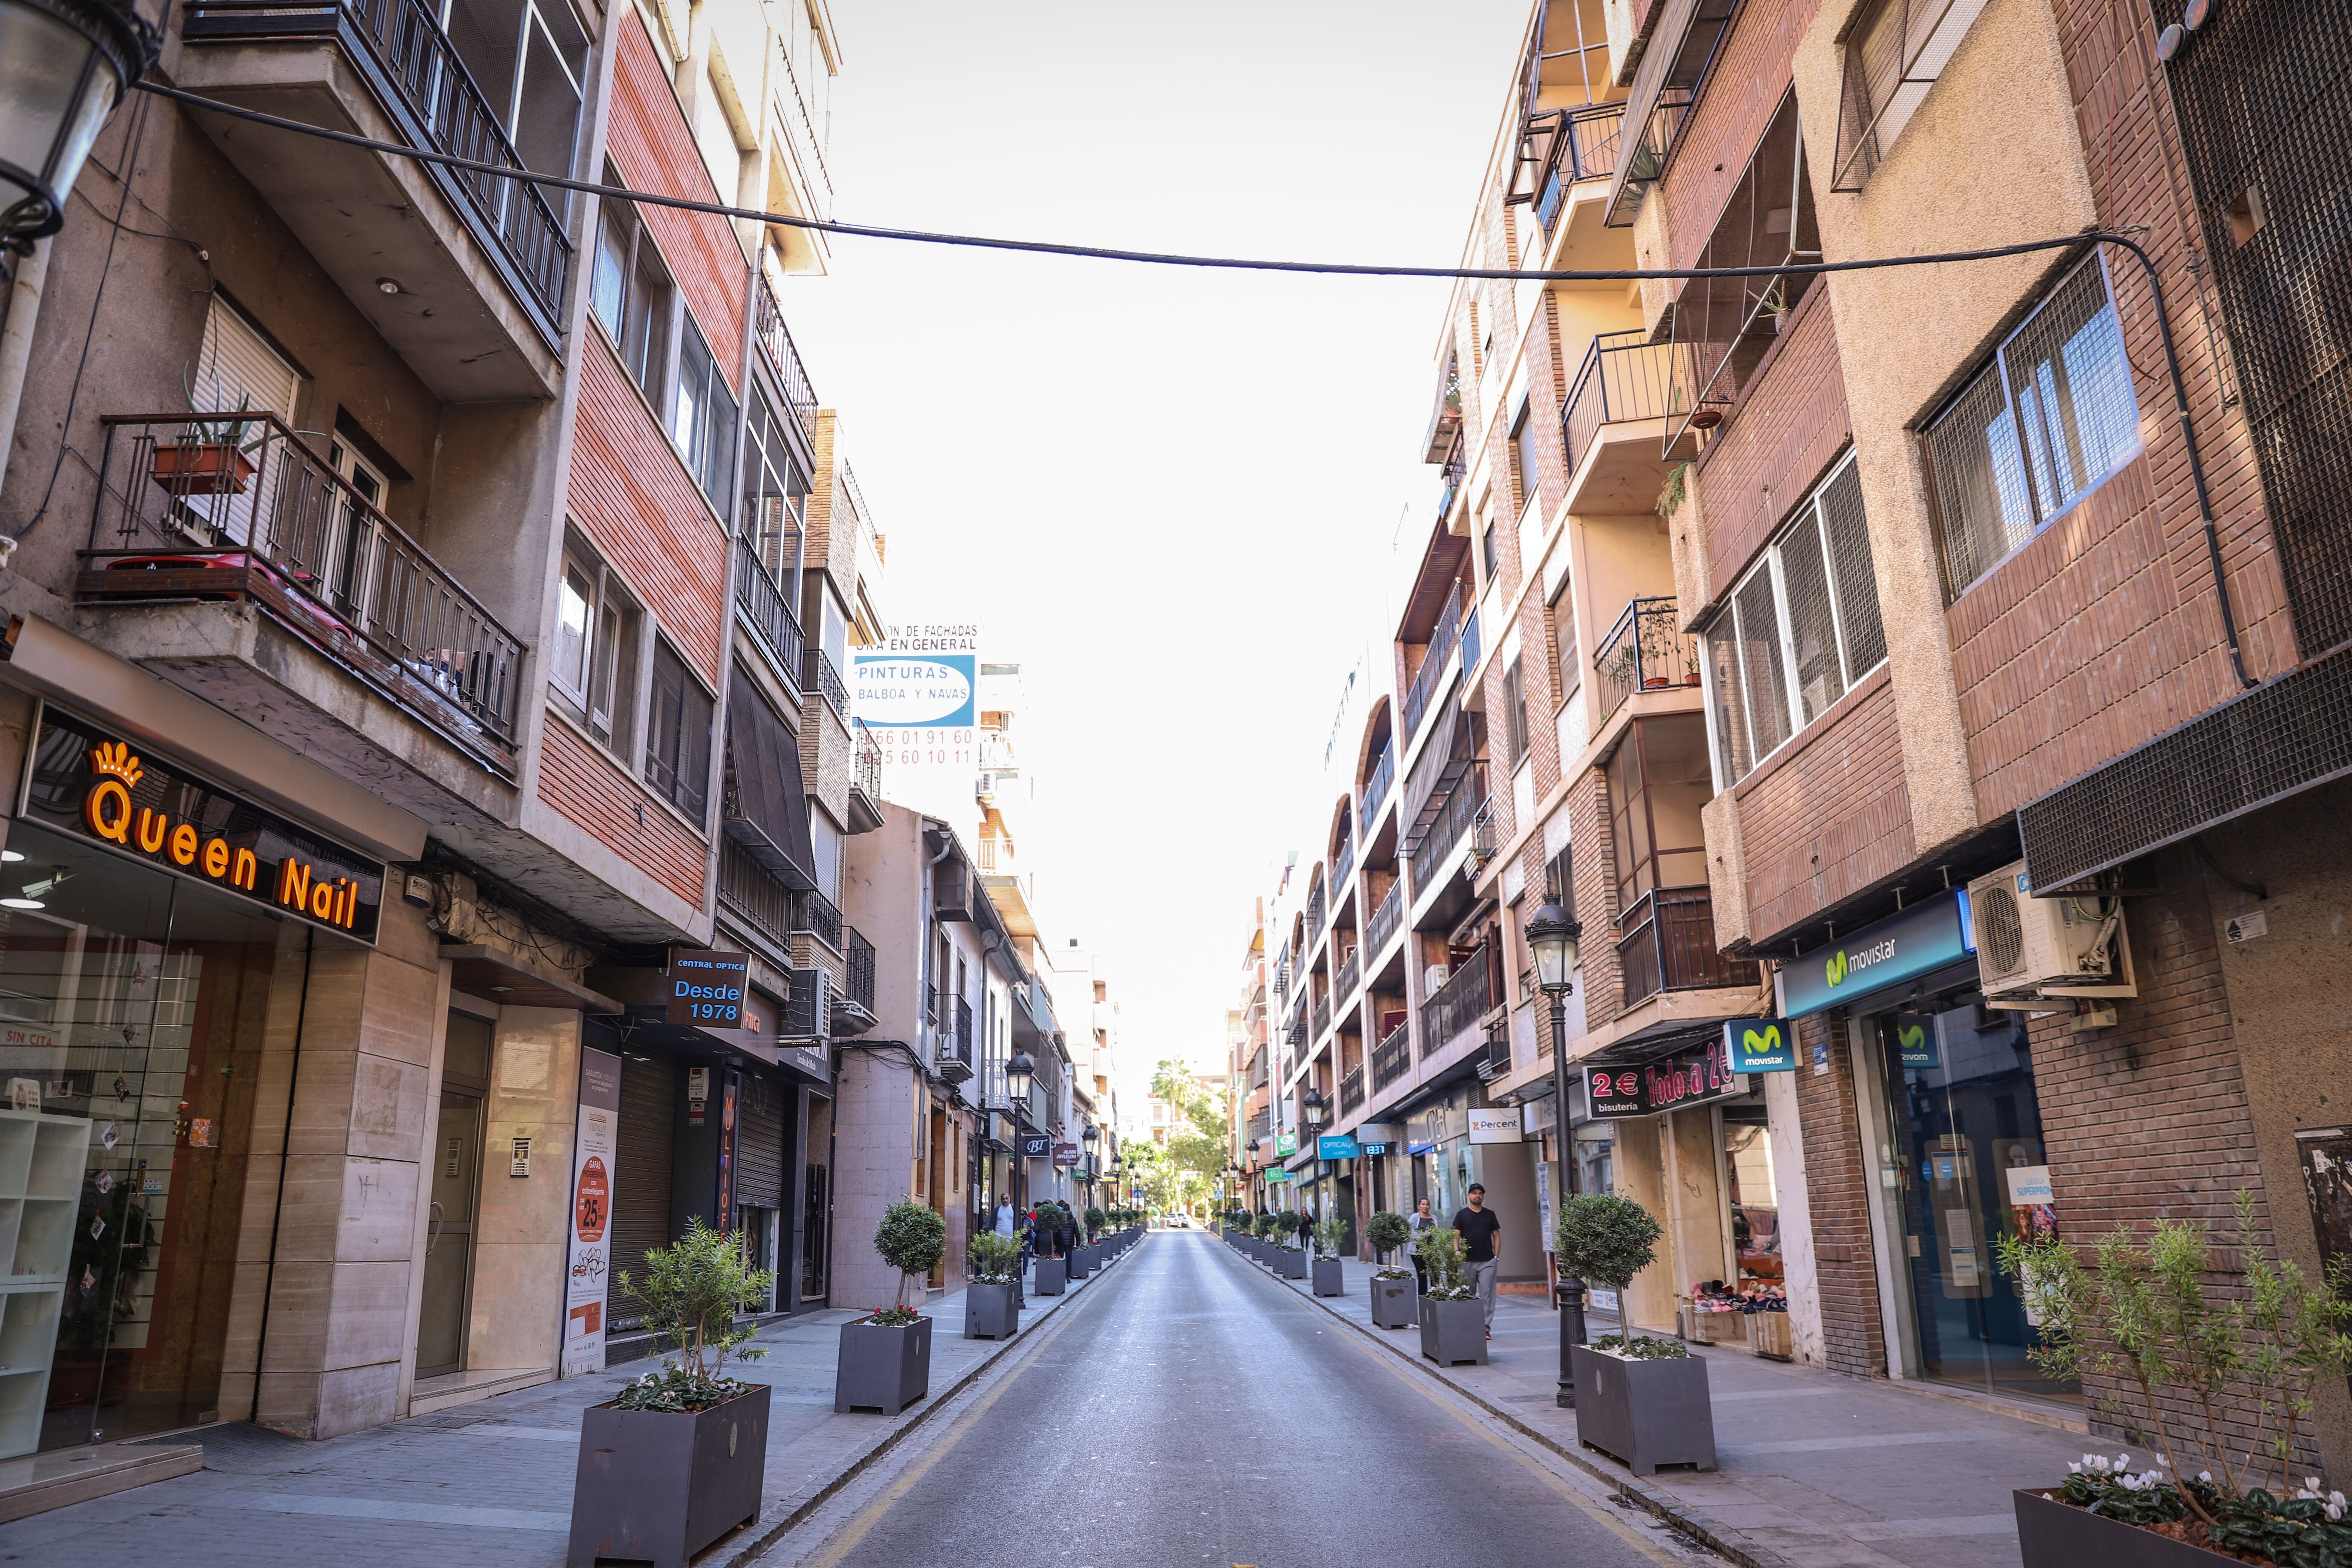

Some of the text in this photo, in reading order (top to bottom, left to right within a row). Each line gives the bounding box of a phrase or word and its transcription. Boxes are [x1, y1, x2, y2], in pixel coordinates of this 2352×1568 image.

[906, 625, 919, 637] DE
[925, 625, 977, 637] FACHADAS
[891, 639, 908, 650] EN
[913, 639, 976, 650] GENERAL
[859, 667, 948, 679] PINTURAS
[859, 688, 967, 699] BALBOA Y NAVAS
[902, 730, 918, 744] 01
[927, 730, 944, 744] 91
[954, 730, 971, 744] 60
[902, 750, 919, 764] 60
[928, 750, 945, 764] 10
[954, 750, 969, 763] 11
[86, 781, 357, 929] Queen Nail
[1849, 939, 1896, 973] movistar
[675, 981, 740, 1001] Desde
[690, 1003, 737, 1020] 1978
[7, 1031, 52, 1047] SIN CITA
[1745, 1057, 1784, 1066] movistar
[1592, 1072, 1638, 1097] 2 €
[1645, 1059, 1685, 1107] Todo
[1690, 1063, 1704, 1095] a
[1598, 1102, 1638, 1112] bisutería
[1481, 1120, 1517, 1128] Percent
[1027, 1139, 1048, 1153] BT
[589, 1160, 601, 1170] GAFAS
[583, 1199, 597, 1227] 25
